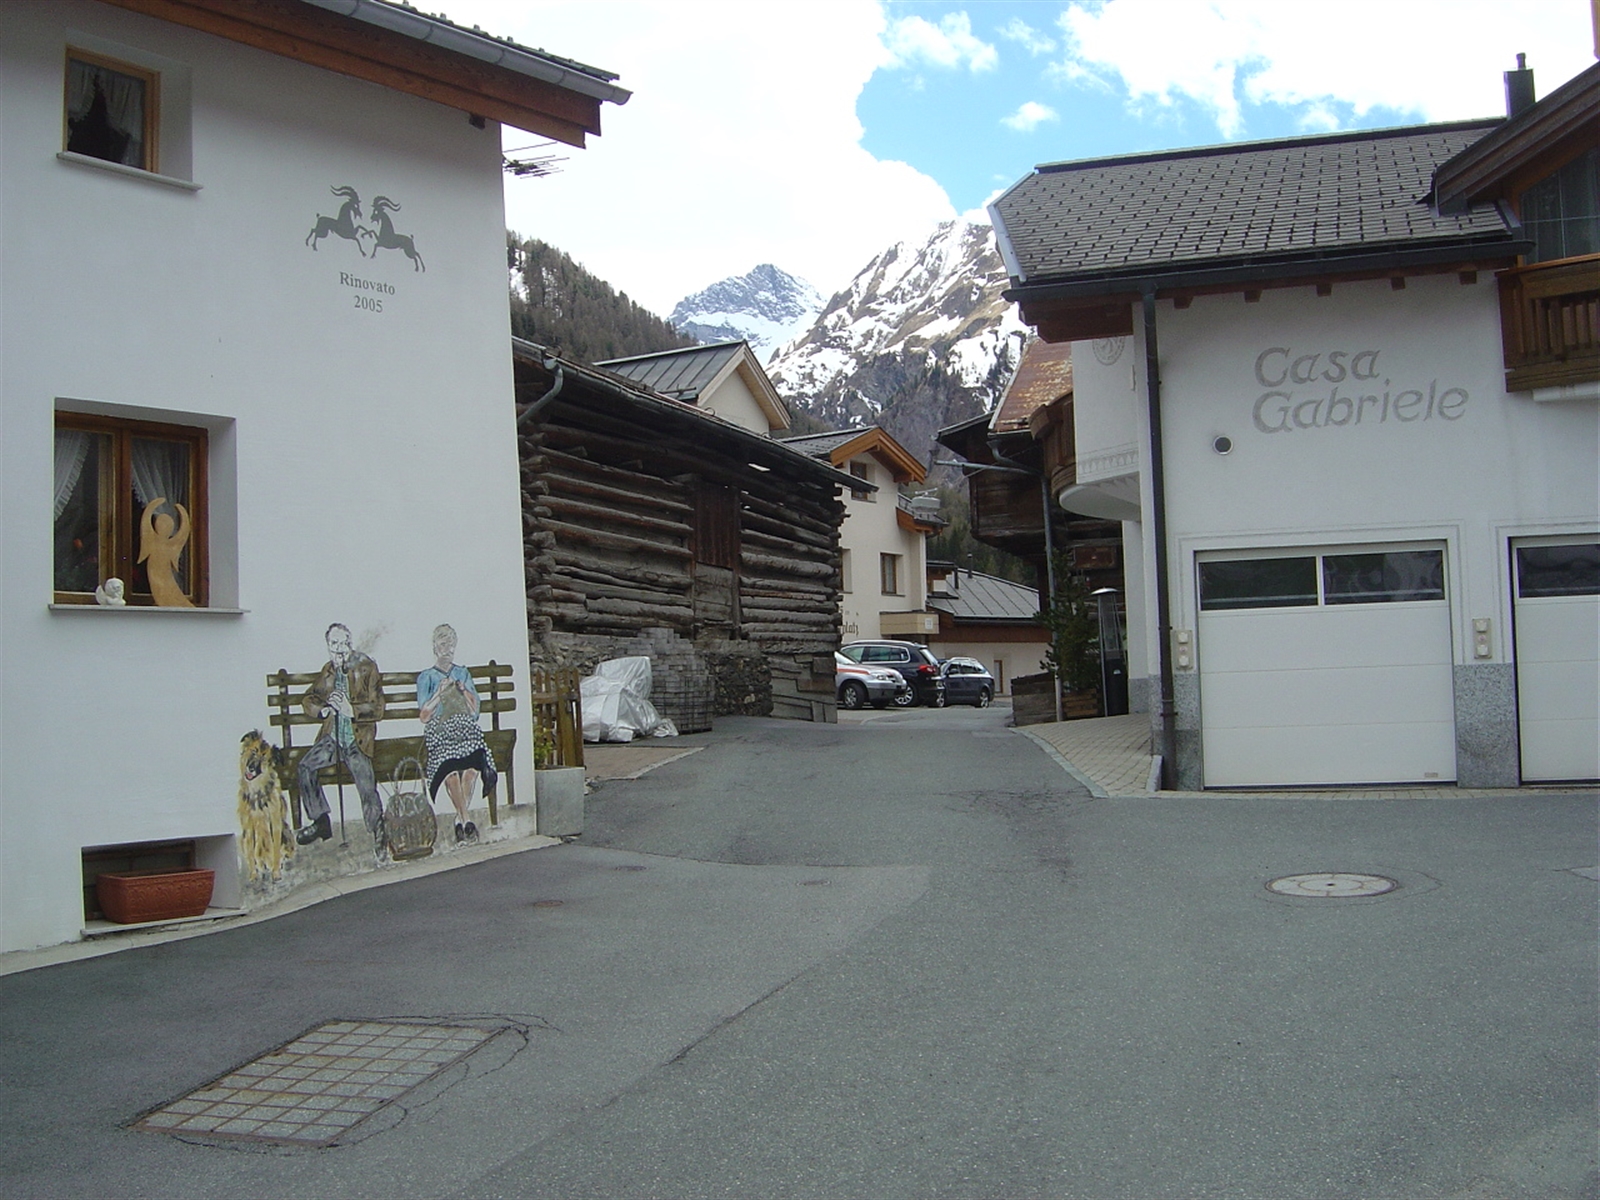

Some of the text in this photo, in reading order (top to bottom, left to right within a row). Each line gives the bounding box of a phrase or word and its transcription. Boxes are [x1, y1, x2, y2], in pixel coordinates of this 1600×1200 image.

[340, 271, 395, 295] Rinovato
[354, 295, 383, 313] 2005
[1254, 347, 1381, 388] Casa
[1252, 378, 1469, 434] Gabriele
